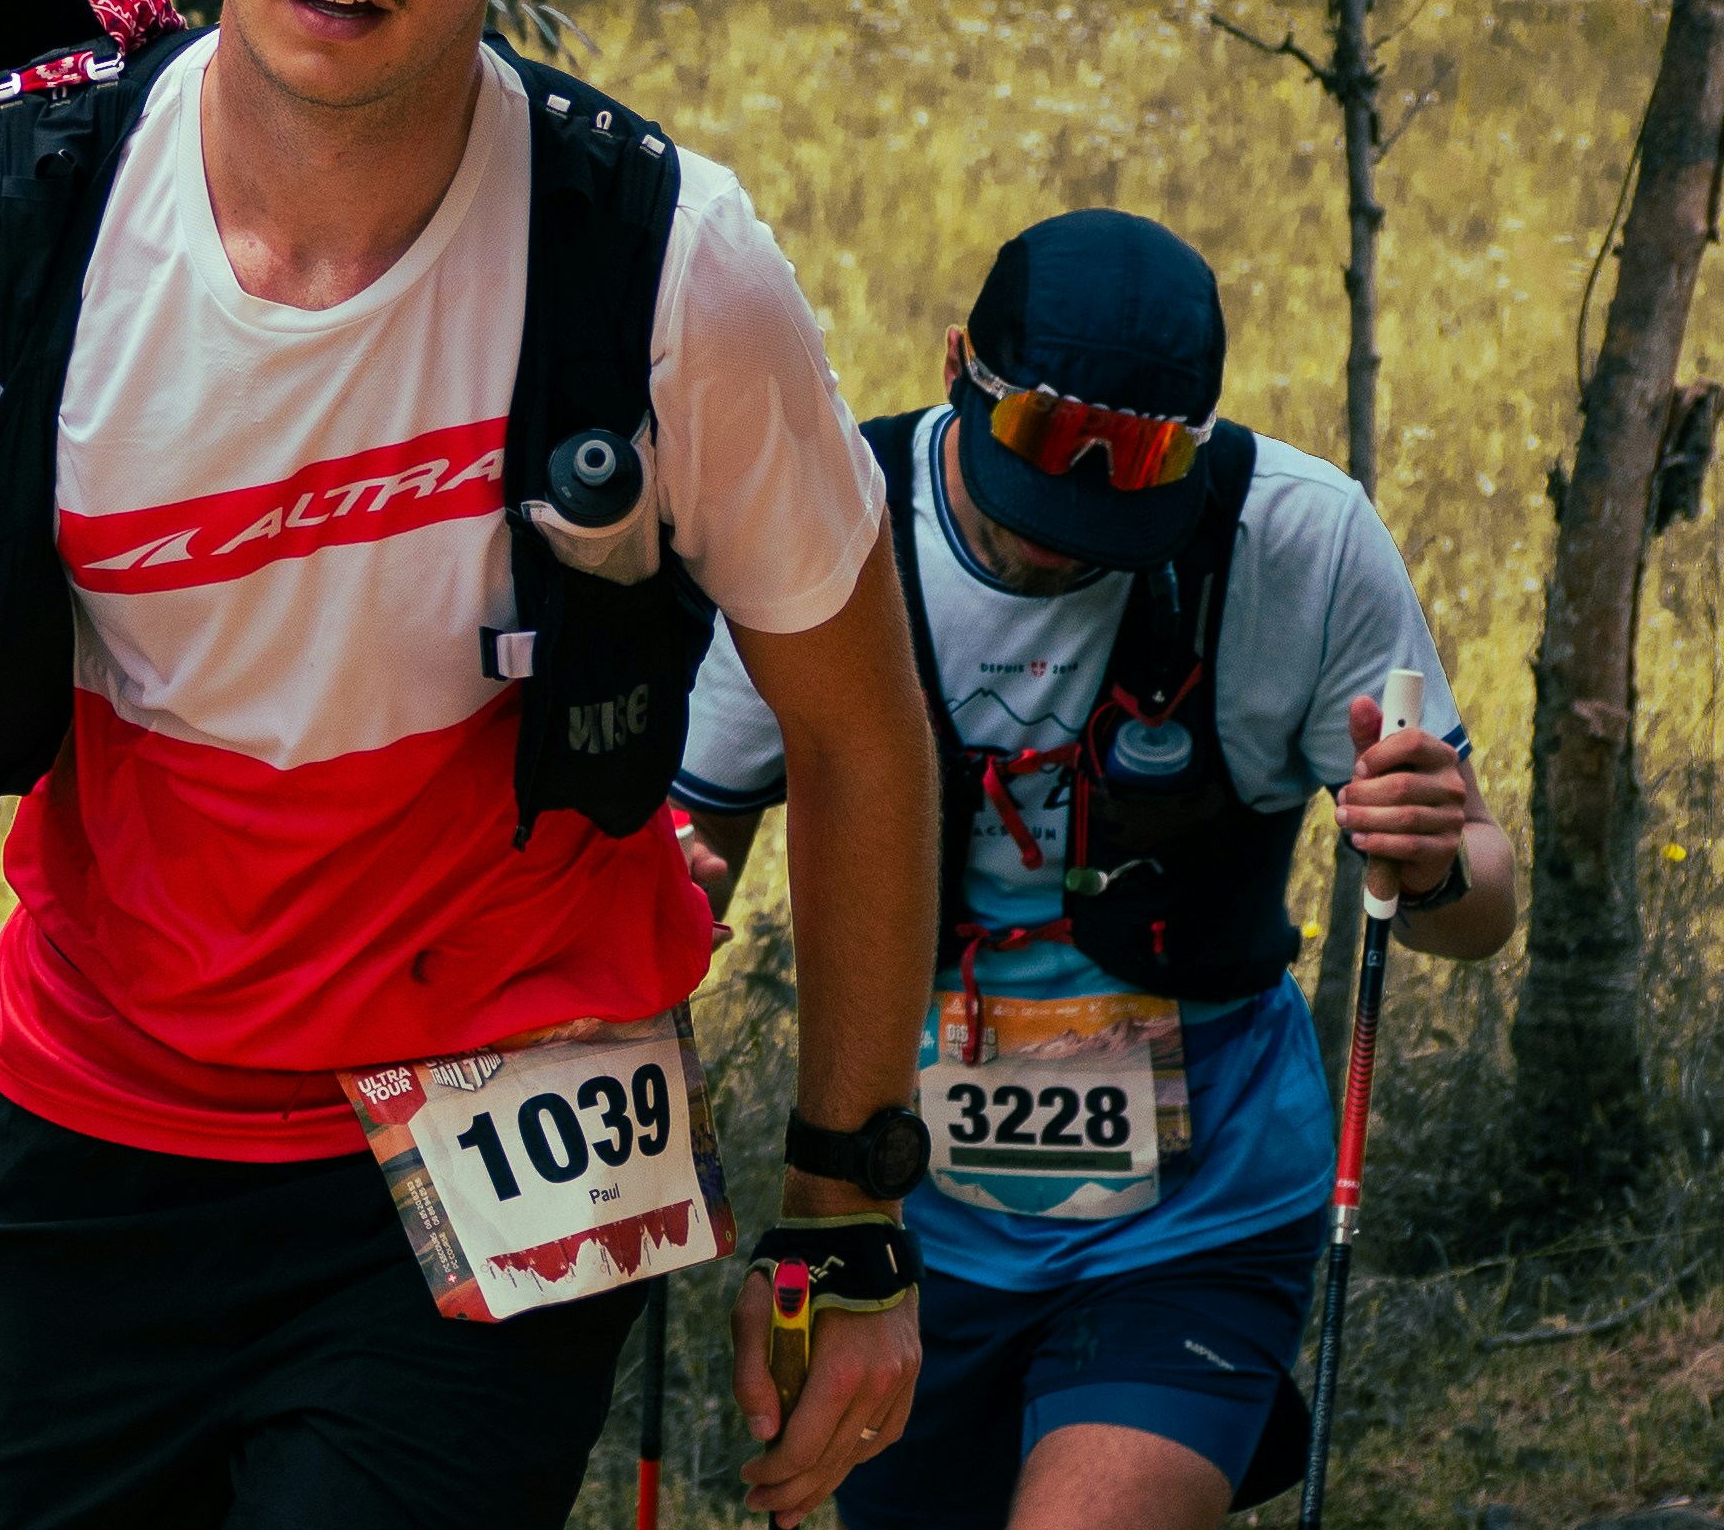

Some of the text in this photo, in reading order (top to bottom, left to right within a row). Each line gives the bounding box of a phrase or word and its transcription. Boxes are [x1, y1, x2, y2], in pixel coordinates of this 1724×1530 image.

[210, 448, 506, 556] ALTRA
[357, 1066, 412, 1094] ULTRA
[462, 1053, 502, 1088] TOUR
[366, 1078, 413, 1105] TOUR
[456, 1063, 671, 1202] 1039
[947, 1083, 1131, 1148] 3228
[589, 1183, 621, 1205] Paul
